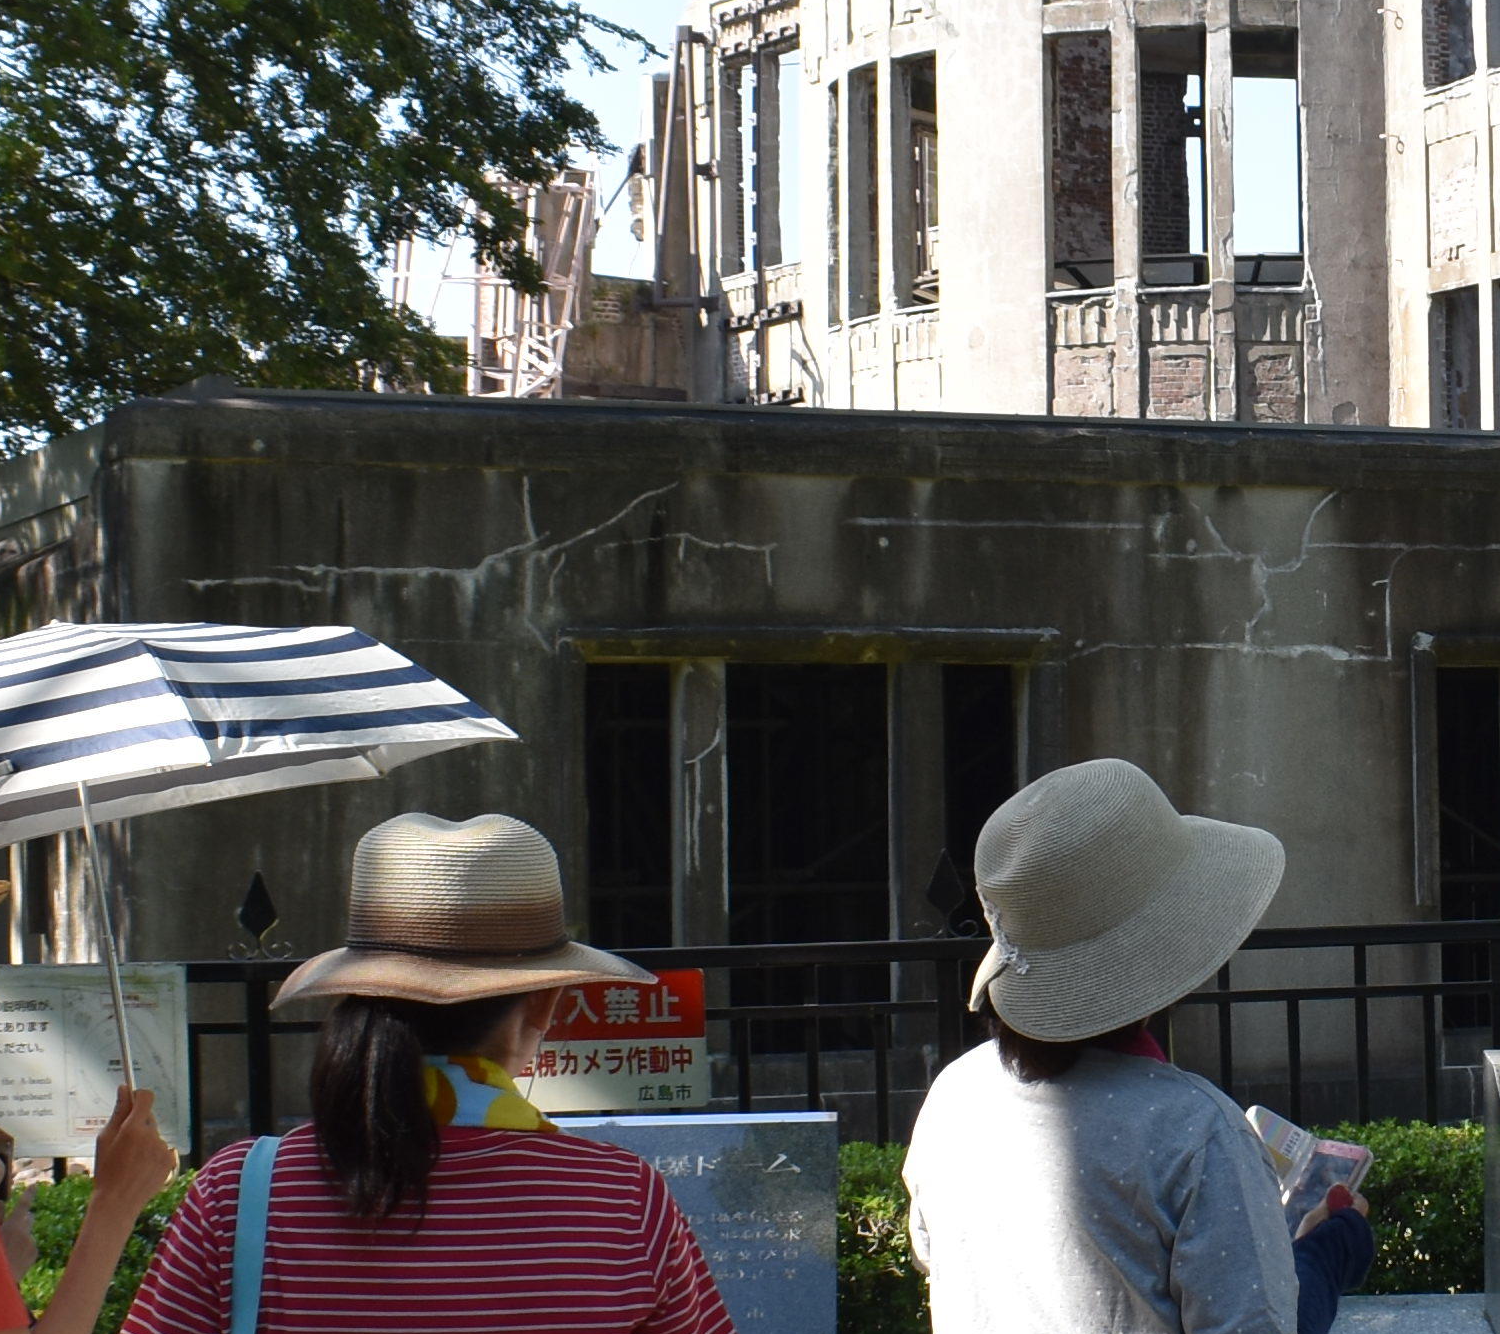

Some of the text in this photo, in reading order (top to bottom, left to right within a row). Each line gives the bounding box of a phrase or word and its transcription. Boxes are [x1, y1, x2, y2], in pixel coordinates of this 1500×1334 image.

[551, 985, 683, 1025] 入禁止
[638, 1083, 693, 1101] 広島市
